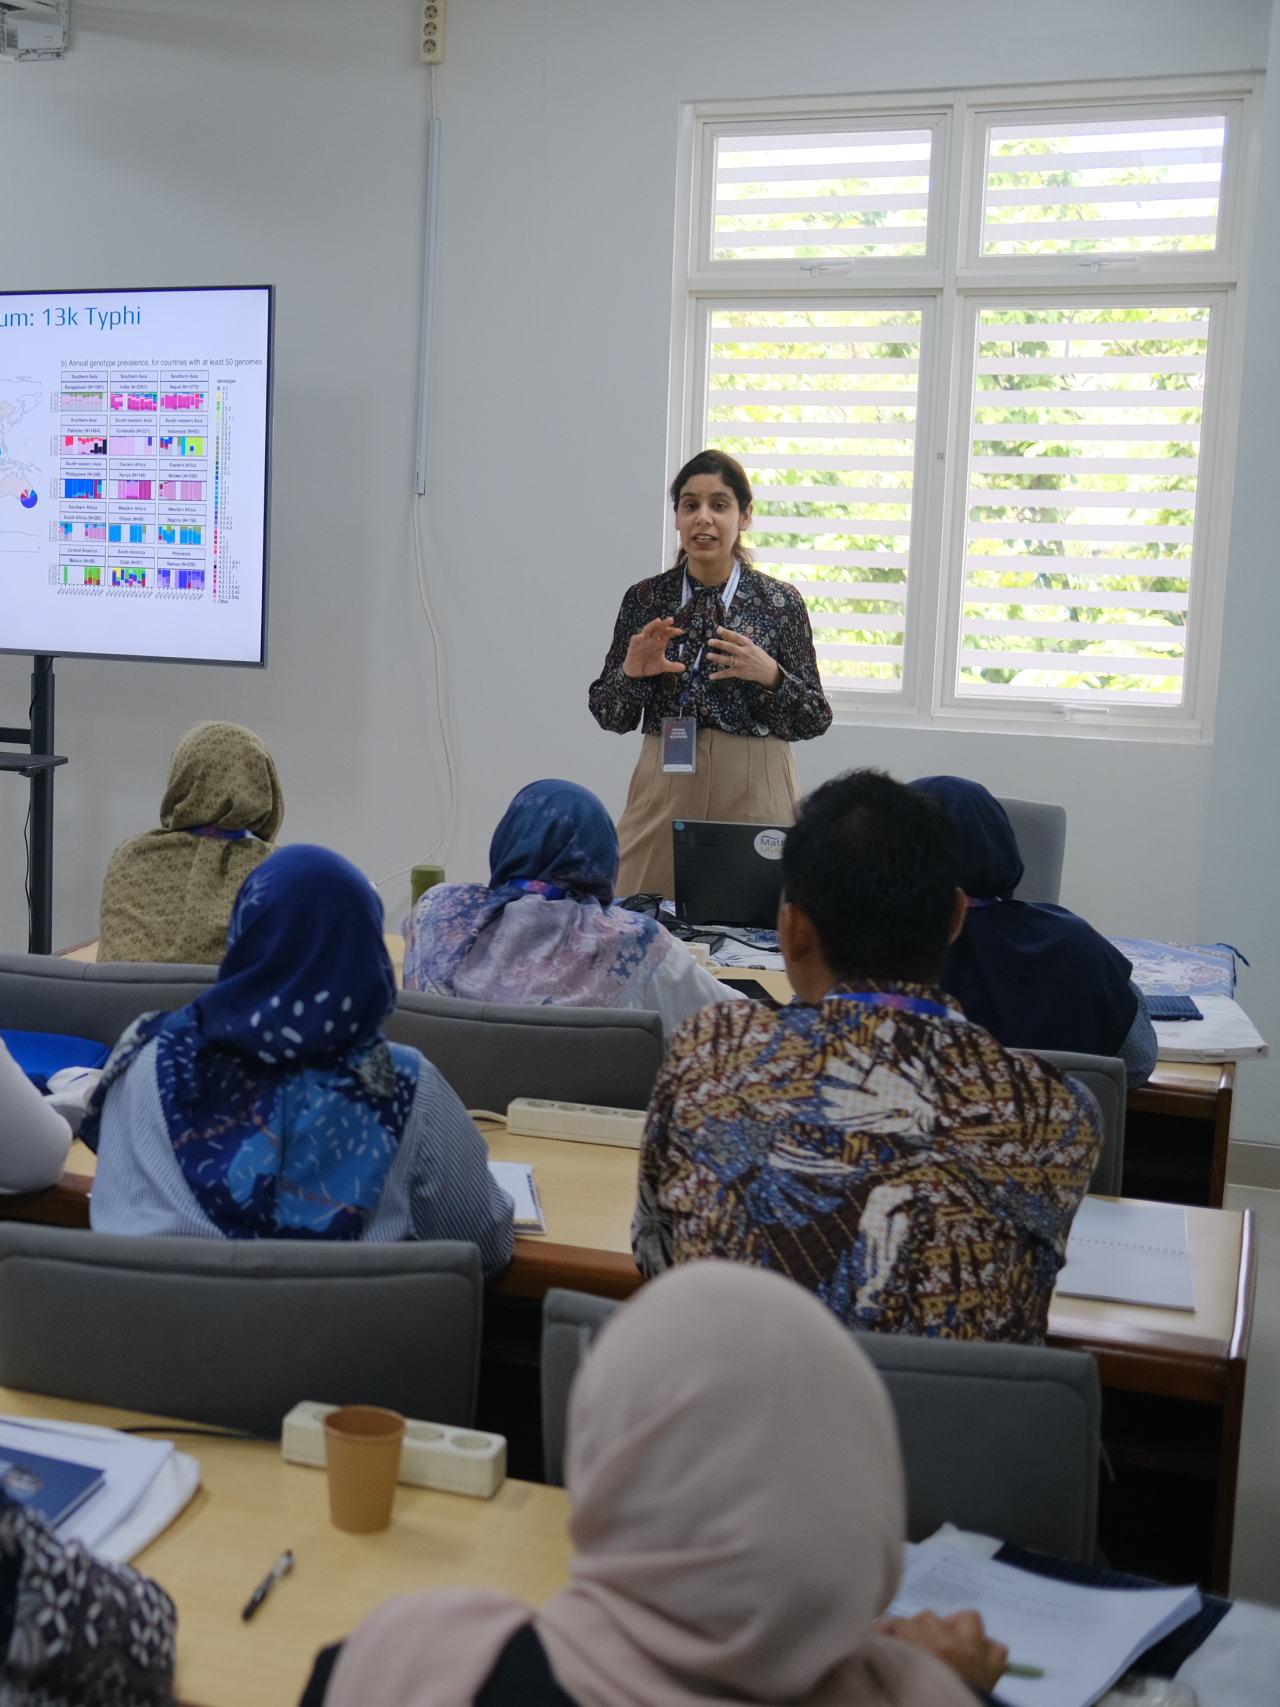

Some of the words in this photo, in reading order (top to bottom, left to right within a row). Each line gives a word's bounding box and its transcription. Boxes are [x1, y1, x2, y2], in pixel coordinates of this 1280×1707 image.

[42, 307, 78, 326] 13k
[84, 306, 140, 330] Typhi
[61, 360, 68, 368] b)
[90, 360, 116, 368] genotype
[117, 359, 150, 368] prevalence,
[234, 359, 262, 367] genomes
